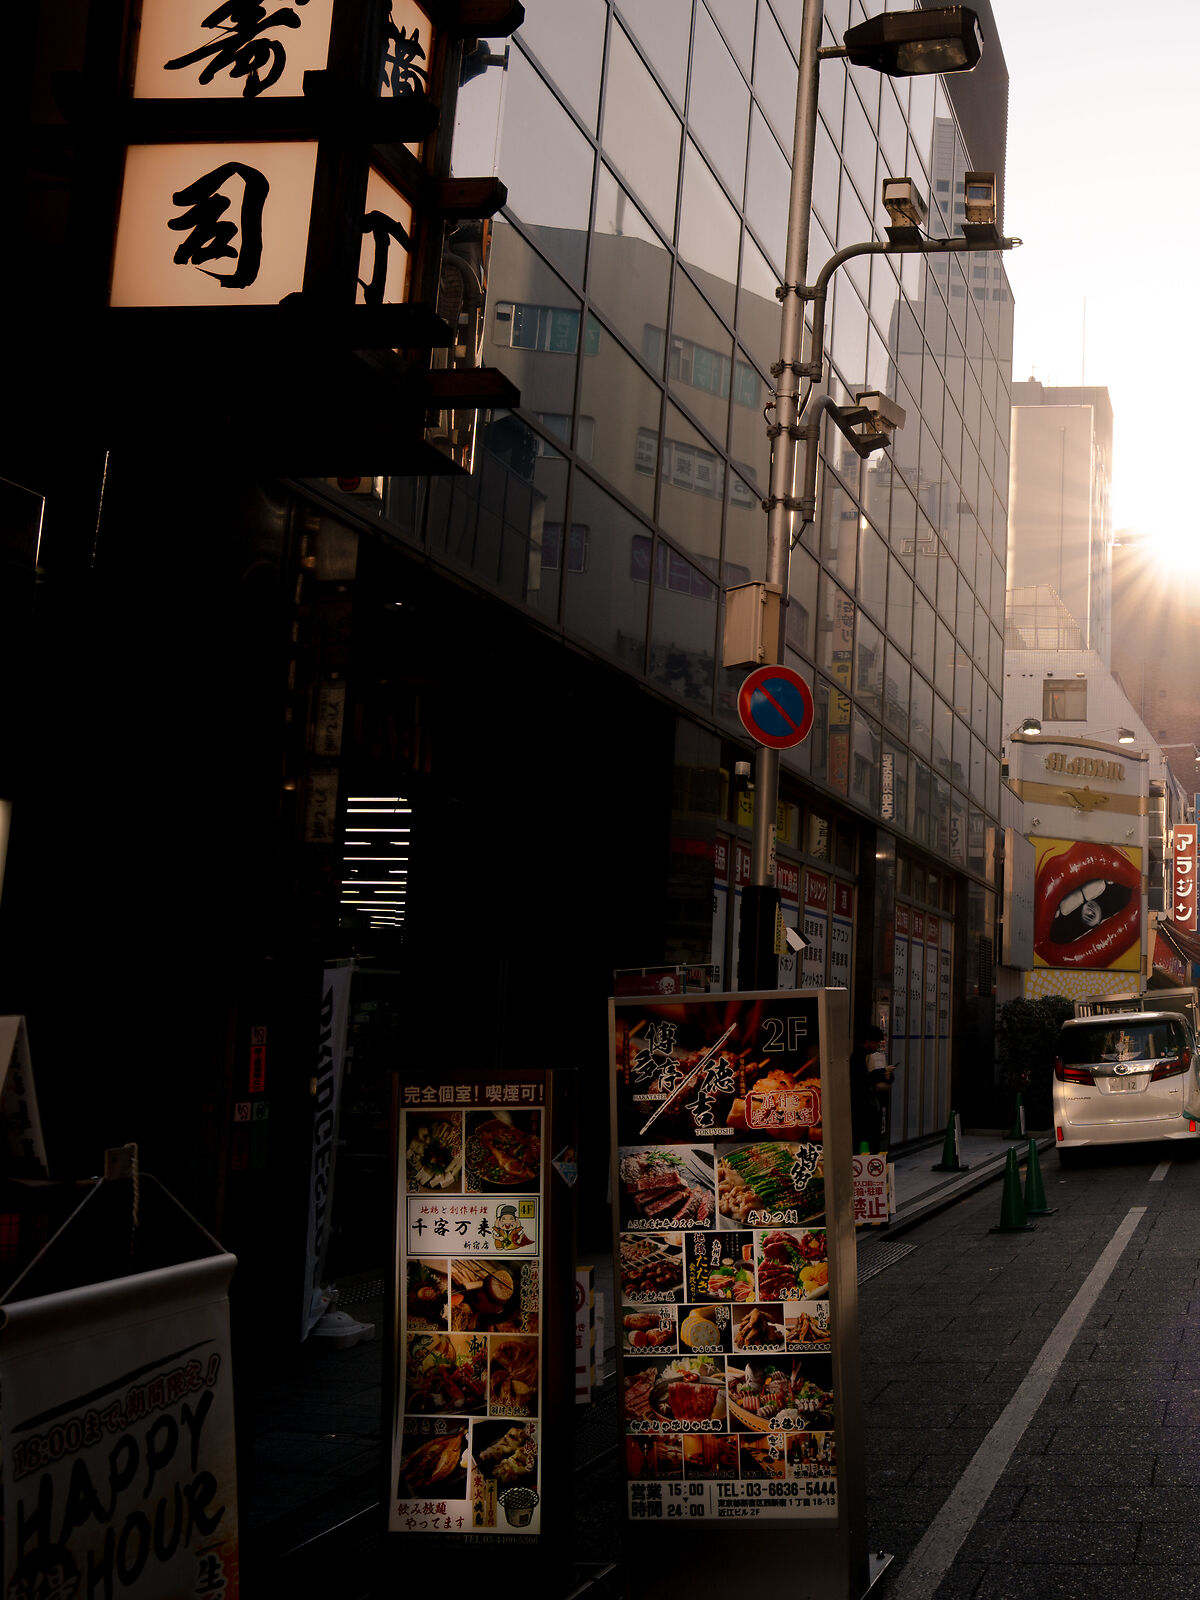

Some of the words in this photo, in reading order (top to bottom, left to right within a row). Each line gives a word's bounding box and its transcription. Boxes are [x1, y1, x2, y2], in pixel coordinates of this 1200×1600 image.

[1175, 833, 1194, 921] アラジン
[810, 877, 827, 901] ドリンク
[762, 1016, 808, 1053] 2F
[695, 1127, 735, 1136] TOKUYOSHI
[521, 1204, 533, 1215] 4F
[747, 1210, 798, 1225] 牛もつ鍋
[411, 1217, 493, 1237] 千客万来
[463, 1240, 489, 1251] 新宿店
[404, 1418, 448, 1436] 焼き魚
[17, 1389, 215, 1569] HAPPY
[631, 1483, 662, 1500] 営業
[667, 1483, 704, 1496] 15:00
[397, 1501, 447, 1516] 飲み放題
[631, 1501, 662, 1518] 時間
[667, 1504, 705, 1517] 24:00
[405, 1516, 465, 1530] やってます
[87, 1471, 227, 1600] HOUR
